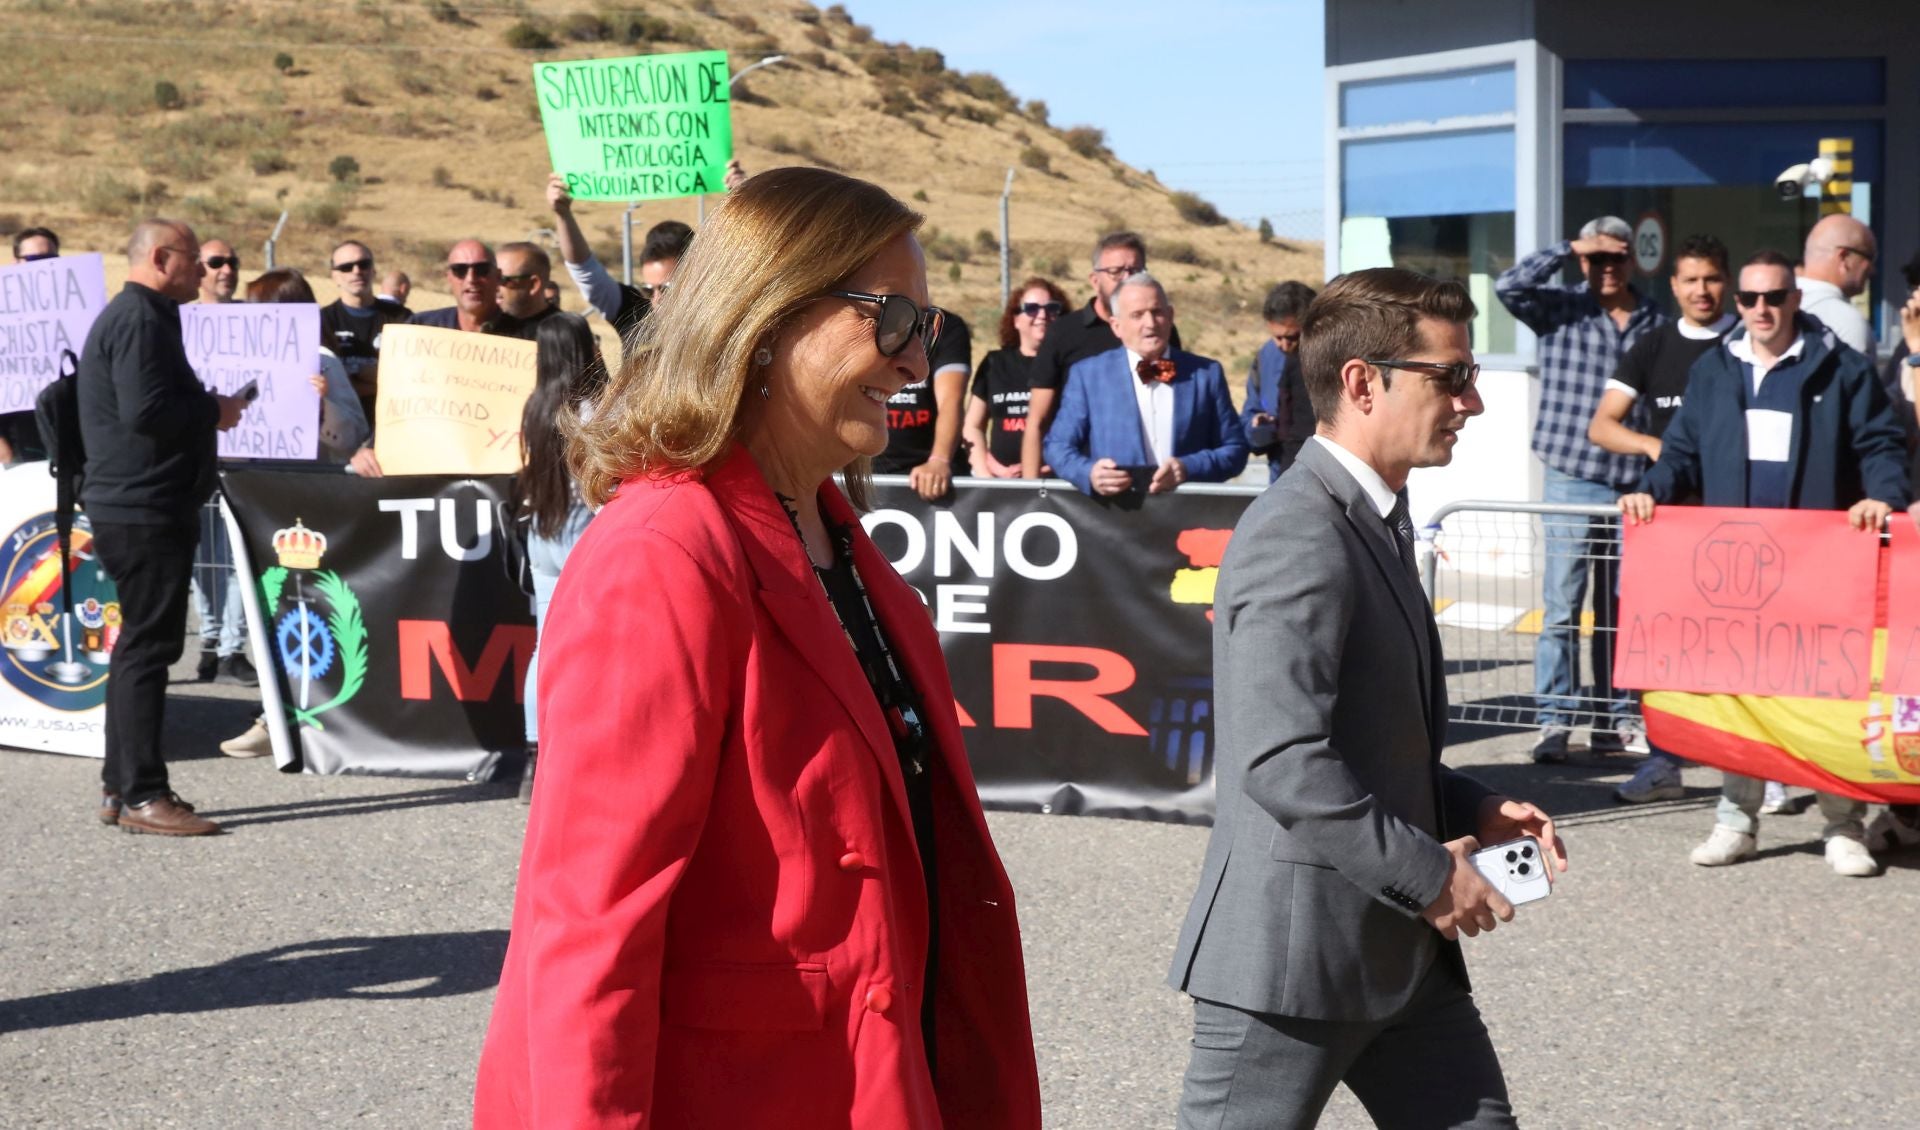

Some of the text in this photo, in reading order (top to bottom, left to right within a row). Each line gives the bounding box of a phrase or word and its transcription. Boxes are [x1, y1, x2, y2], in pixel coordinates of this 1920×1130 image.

[698, 61, 728, 103] DE
[666, 111, 709, 138] CON
[0, 263, 86, 314] ENCIA
[887, 409, 931, 430] TAR
[378, 499, 492, 561] TU
[1701, 539, 1776, 599] STOP
[1619, 612, 1865, 700] AGRESIONES
